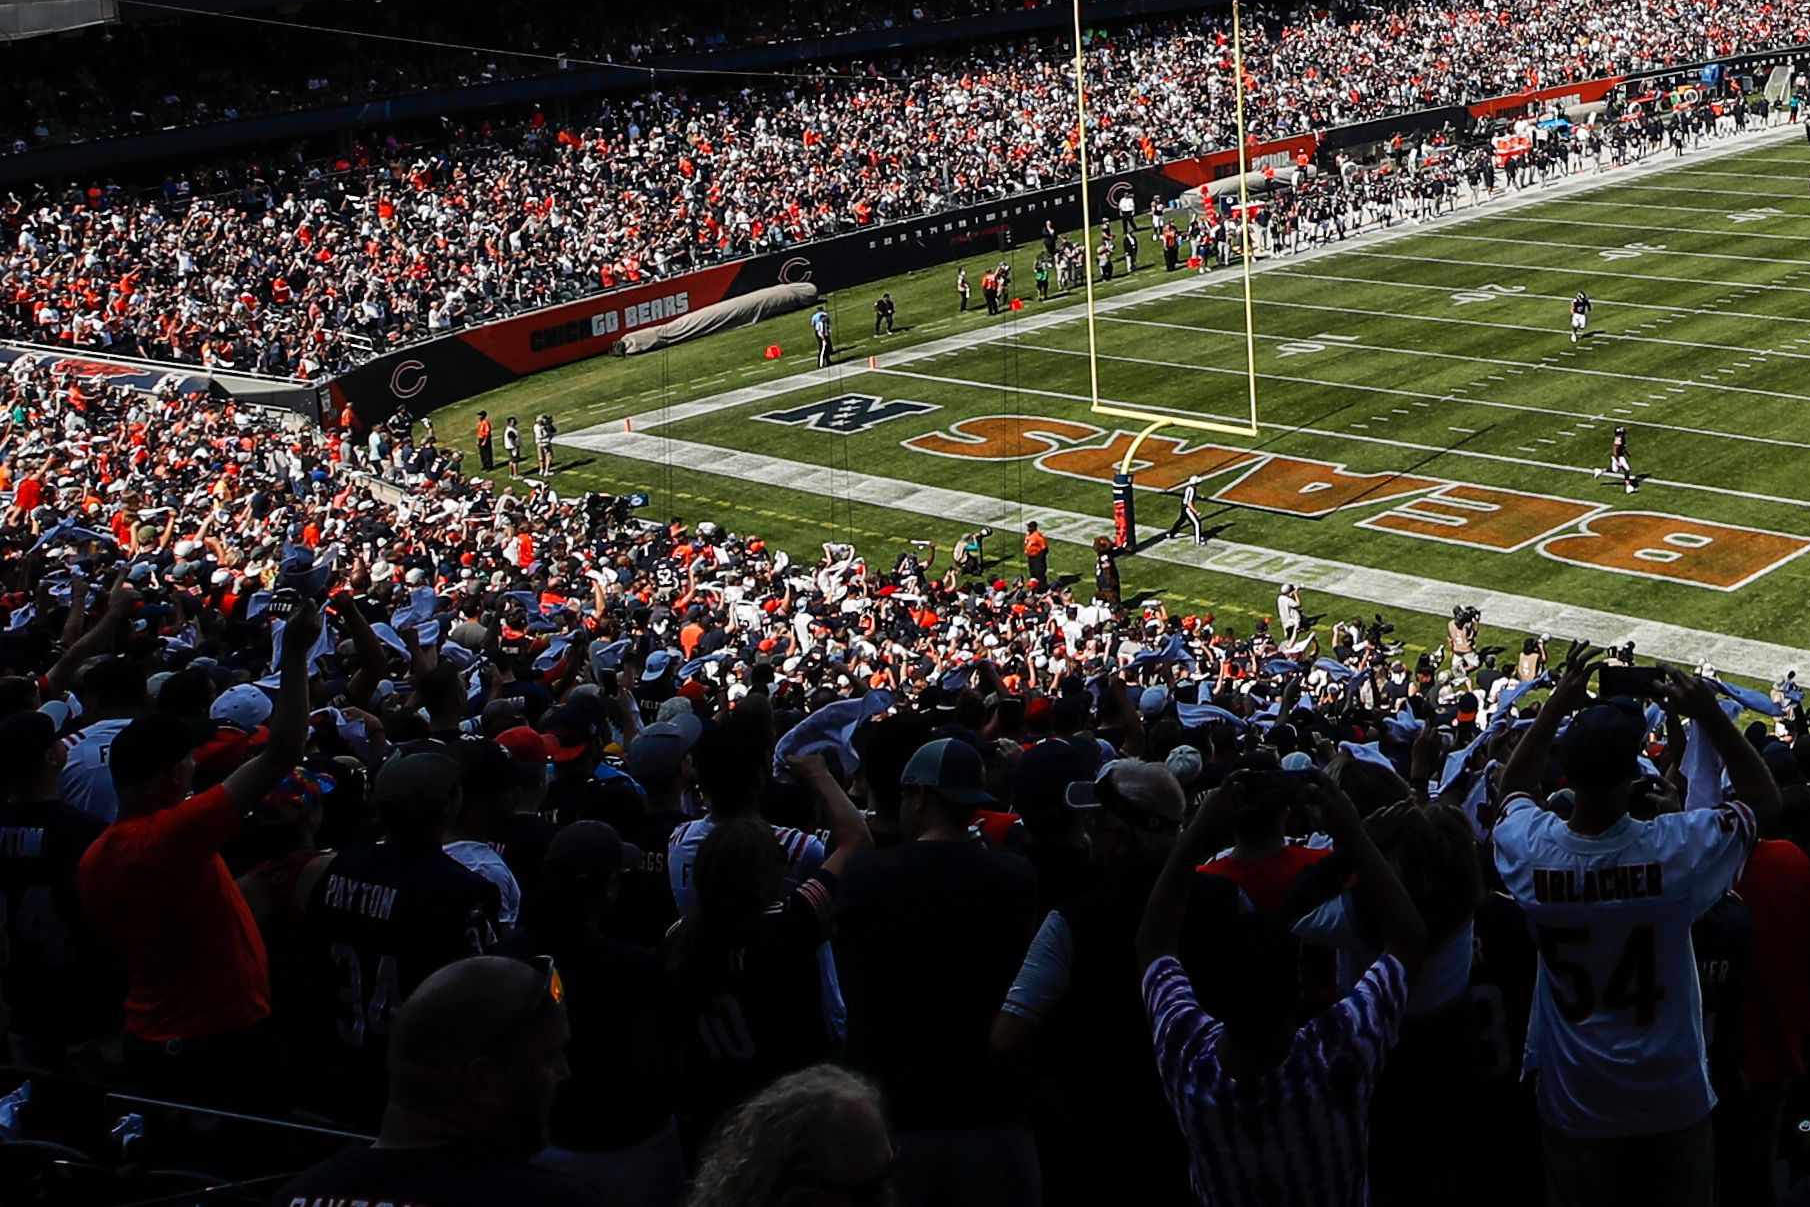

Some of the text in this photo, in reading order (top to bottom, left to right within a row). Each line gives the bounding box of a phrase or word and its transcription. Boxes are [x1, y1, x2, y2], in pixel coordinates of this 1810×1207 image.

[625, 291, 690, 329] BEARS
[1449, 283, 1526, 306] 20
[1275, 332, 1361, 359] 10
[390, 359, 428, 399] C
[324, 873, 399, 921] PAYTON
[1533, 863, 1663, 903] URLACHER
[1537, 923, 1665, 1028] 54
